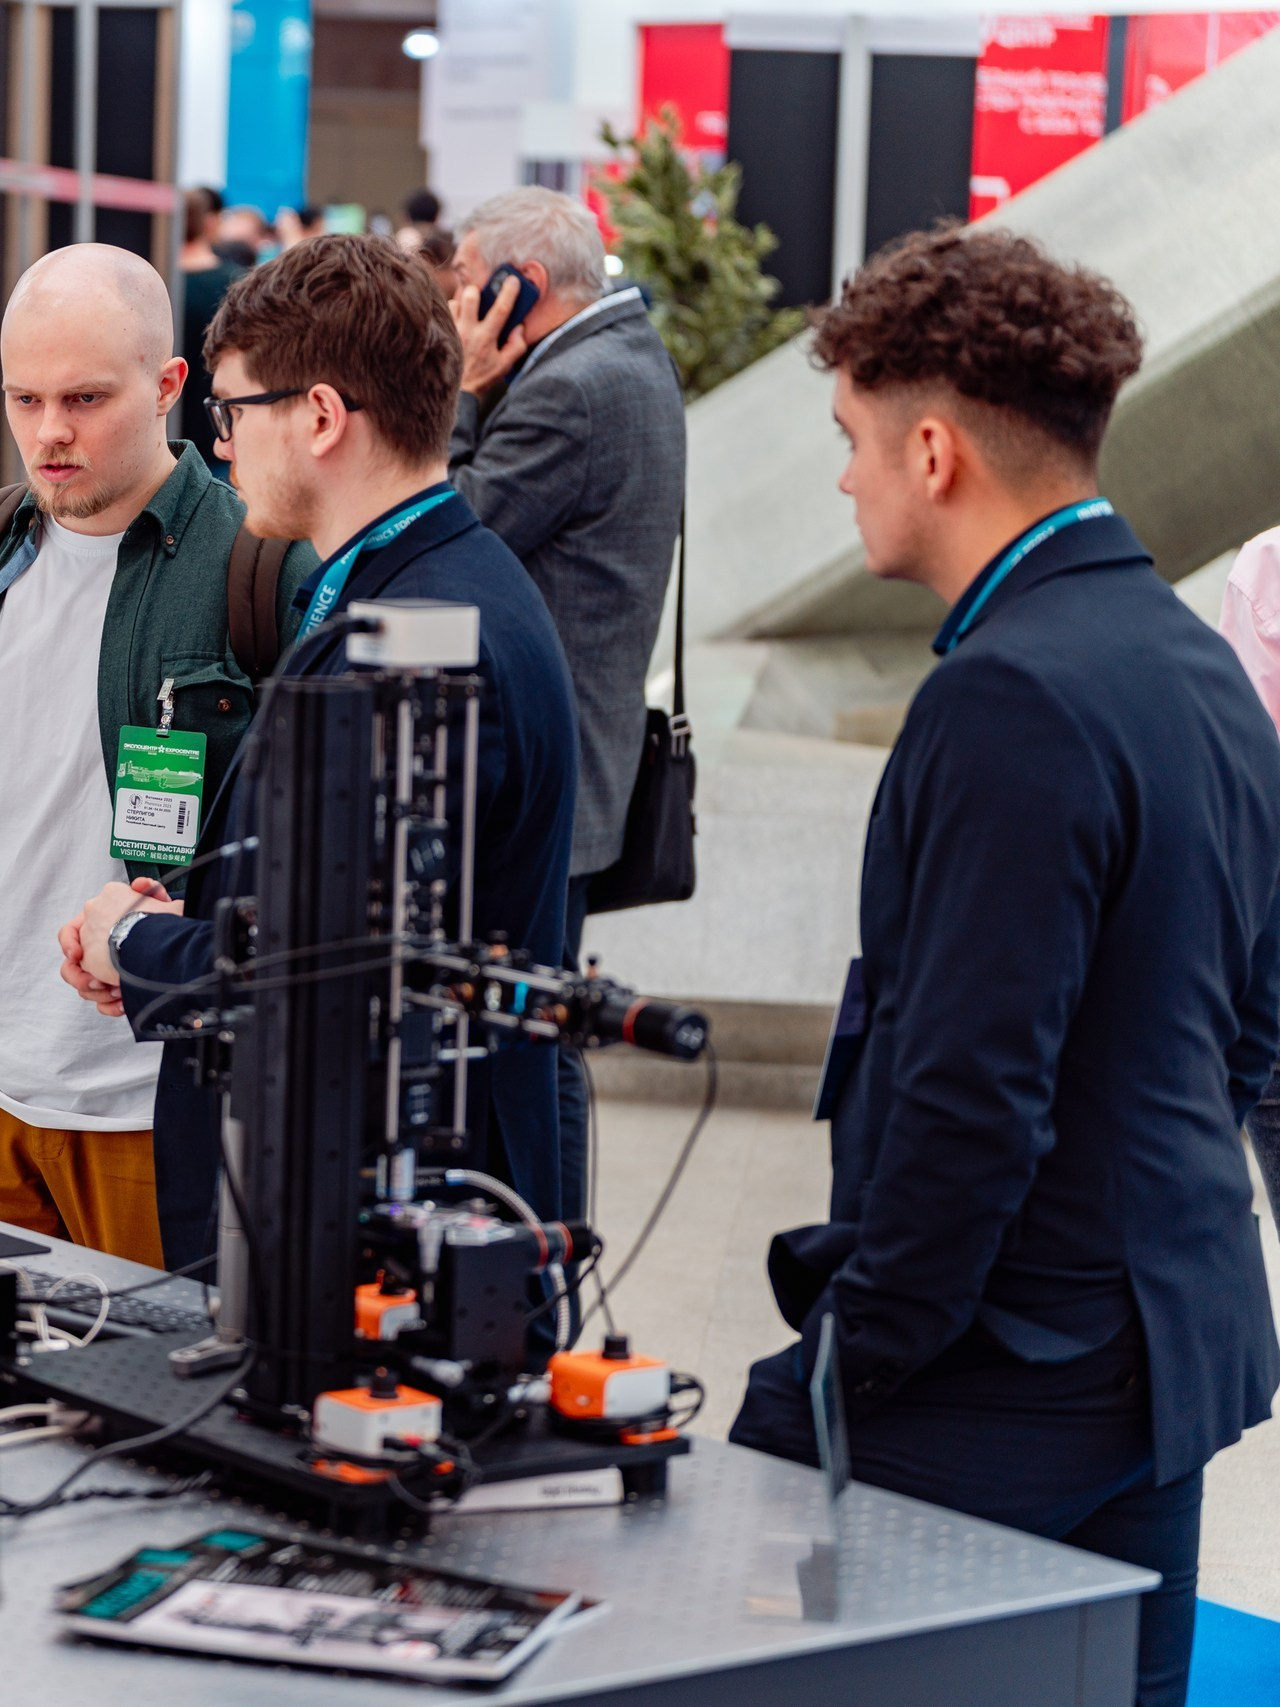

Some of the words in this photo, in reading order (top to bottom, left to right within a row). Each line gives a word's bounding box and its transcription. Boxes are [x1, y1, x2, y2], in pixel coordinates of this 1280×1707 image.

[303, 585, 336, 637] CIENCE
[165, 748, 200, 756] EXPOCENTRE
[113, 840, 156, 851] ПОСЕТИТЕЛЬ
[157, 845, 196, 854] ВЫСТАВКИ
[120, 849, 146, 857] VISITOR
